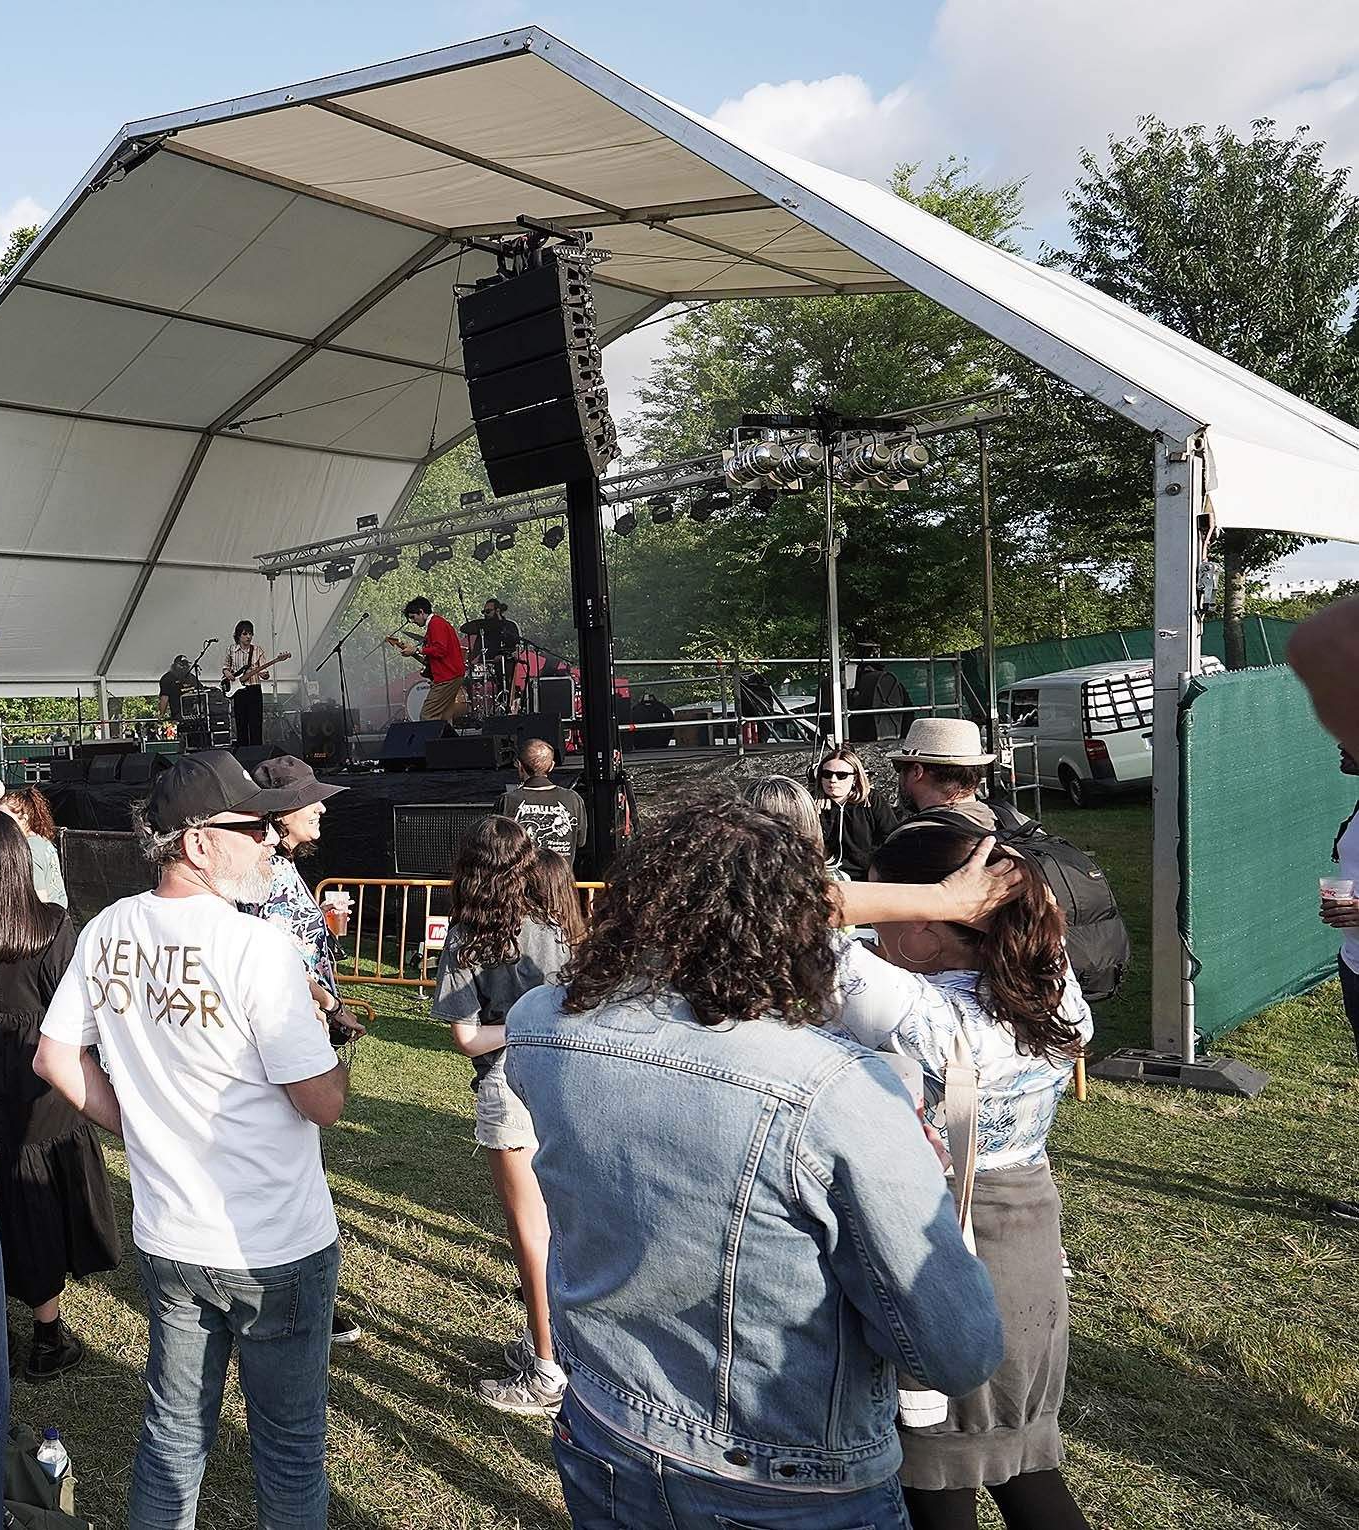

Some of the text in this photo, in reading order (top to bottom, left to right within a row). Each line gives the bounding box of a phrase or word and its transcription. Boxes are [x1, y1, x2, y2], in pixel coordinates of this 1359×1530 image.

[95, 937, 201, 984] XENTE
[86, 975, 224, 1028] DO MAR
